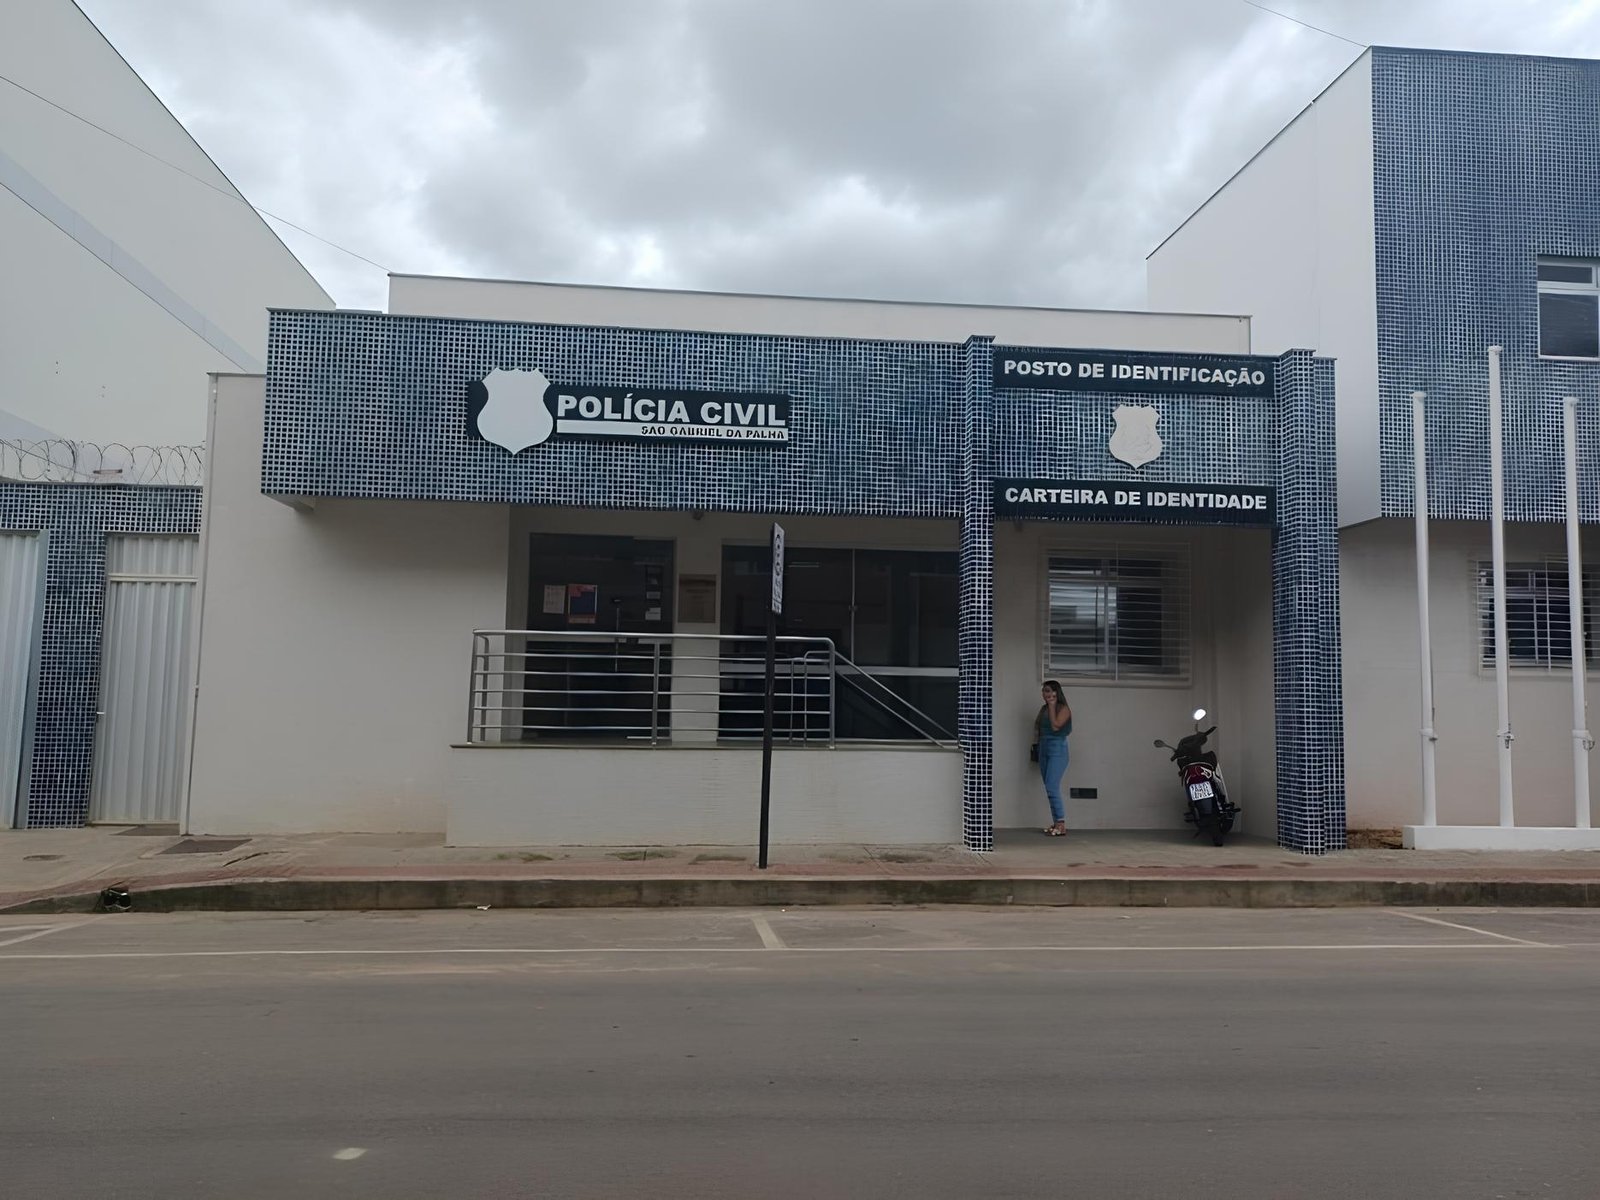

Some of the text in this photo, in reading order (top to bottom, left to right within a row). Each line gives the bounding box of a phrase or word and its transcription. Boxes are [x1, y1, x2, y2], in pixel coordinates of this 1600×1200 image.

[1004, 360, 1266, 387] POSTO DE IDENTIFICAÇÃO
[557, 393, 786, 426] POLÍCIA CIVIL
[726, 429, 742, 438] DA
[745, 430, 785, 439] PALHA
[1005, 487, 1267, 510] CARTEIRA DE IDENTIDADE
